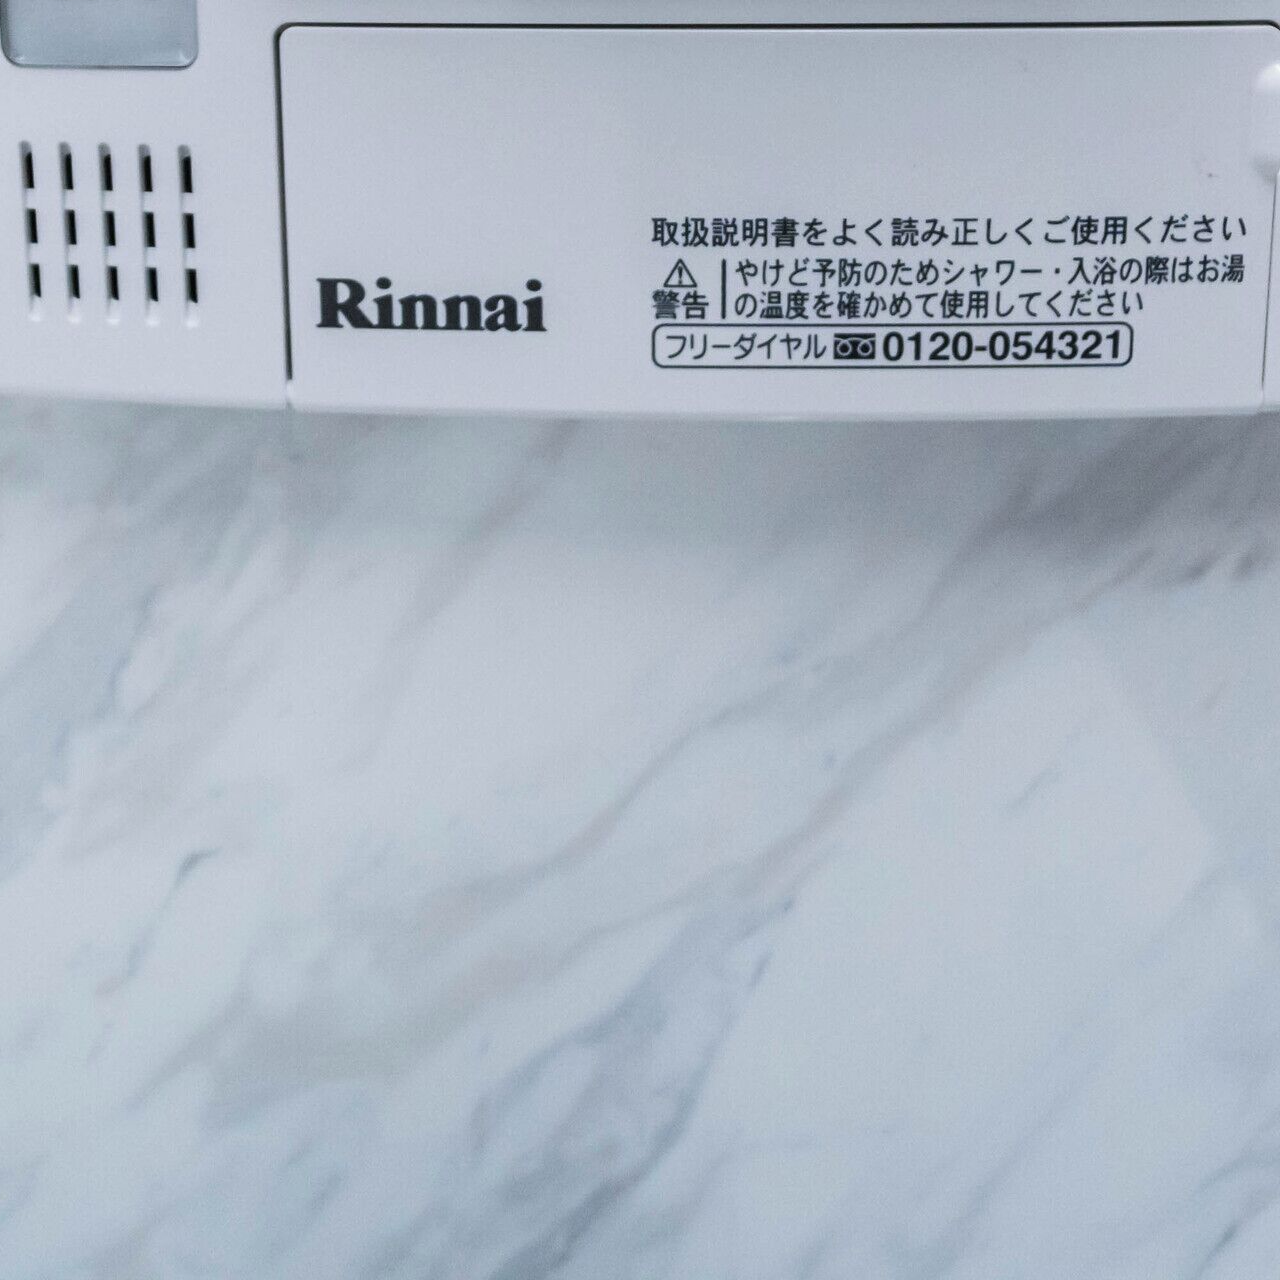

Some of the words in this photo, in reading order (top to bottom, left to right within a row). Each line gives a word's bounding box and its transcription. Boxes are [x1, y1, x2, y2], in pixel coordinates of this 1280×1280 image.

[652, 216, 1248, 248] 取扱説明書をよく読み正しくご使用ください
[317, 278, 547, 333] Rinnai
[653, 290, 710, 320] 警告
[734, 291, 1145, 319] の温度を確かめて使用してください
[665, 334, 827, 360] フリーダイヤル
[882, 331, 1122, 362] 0120-054321
